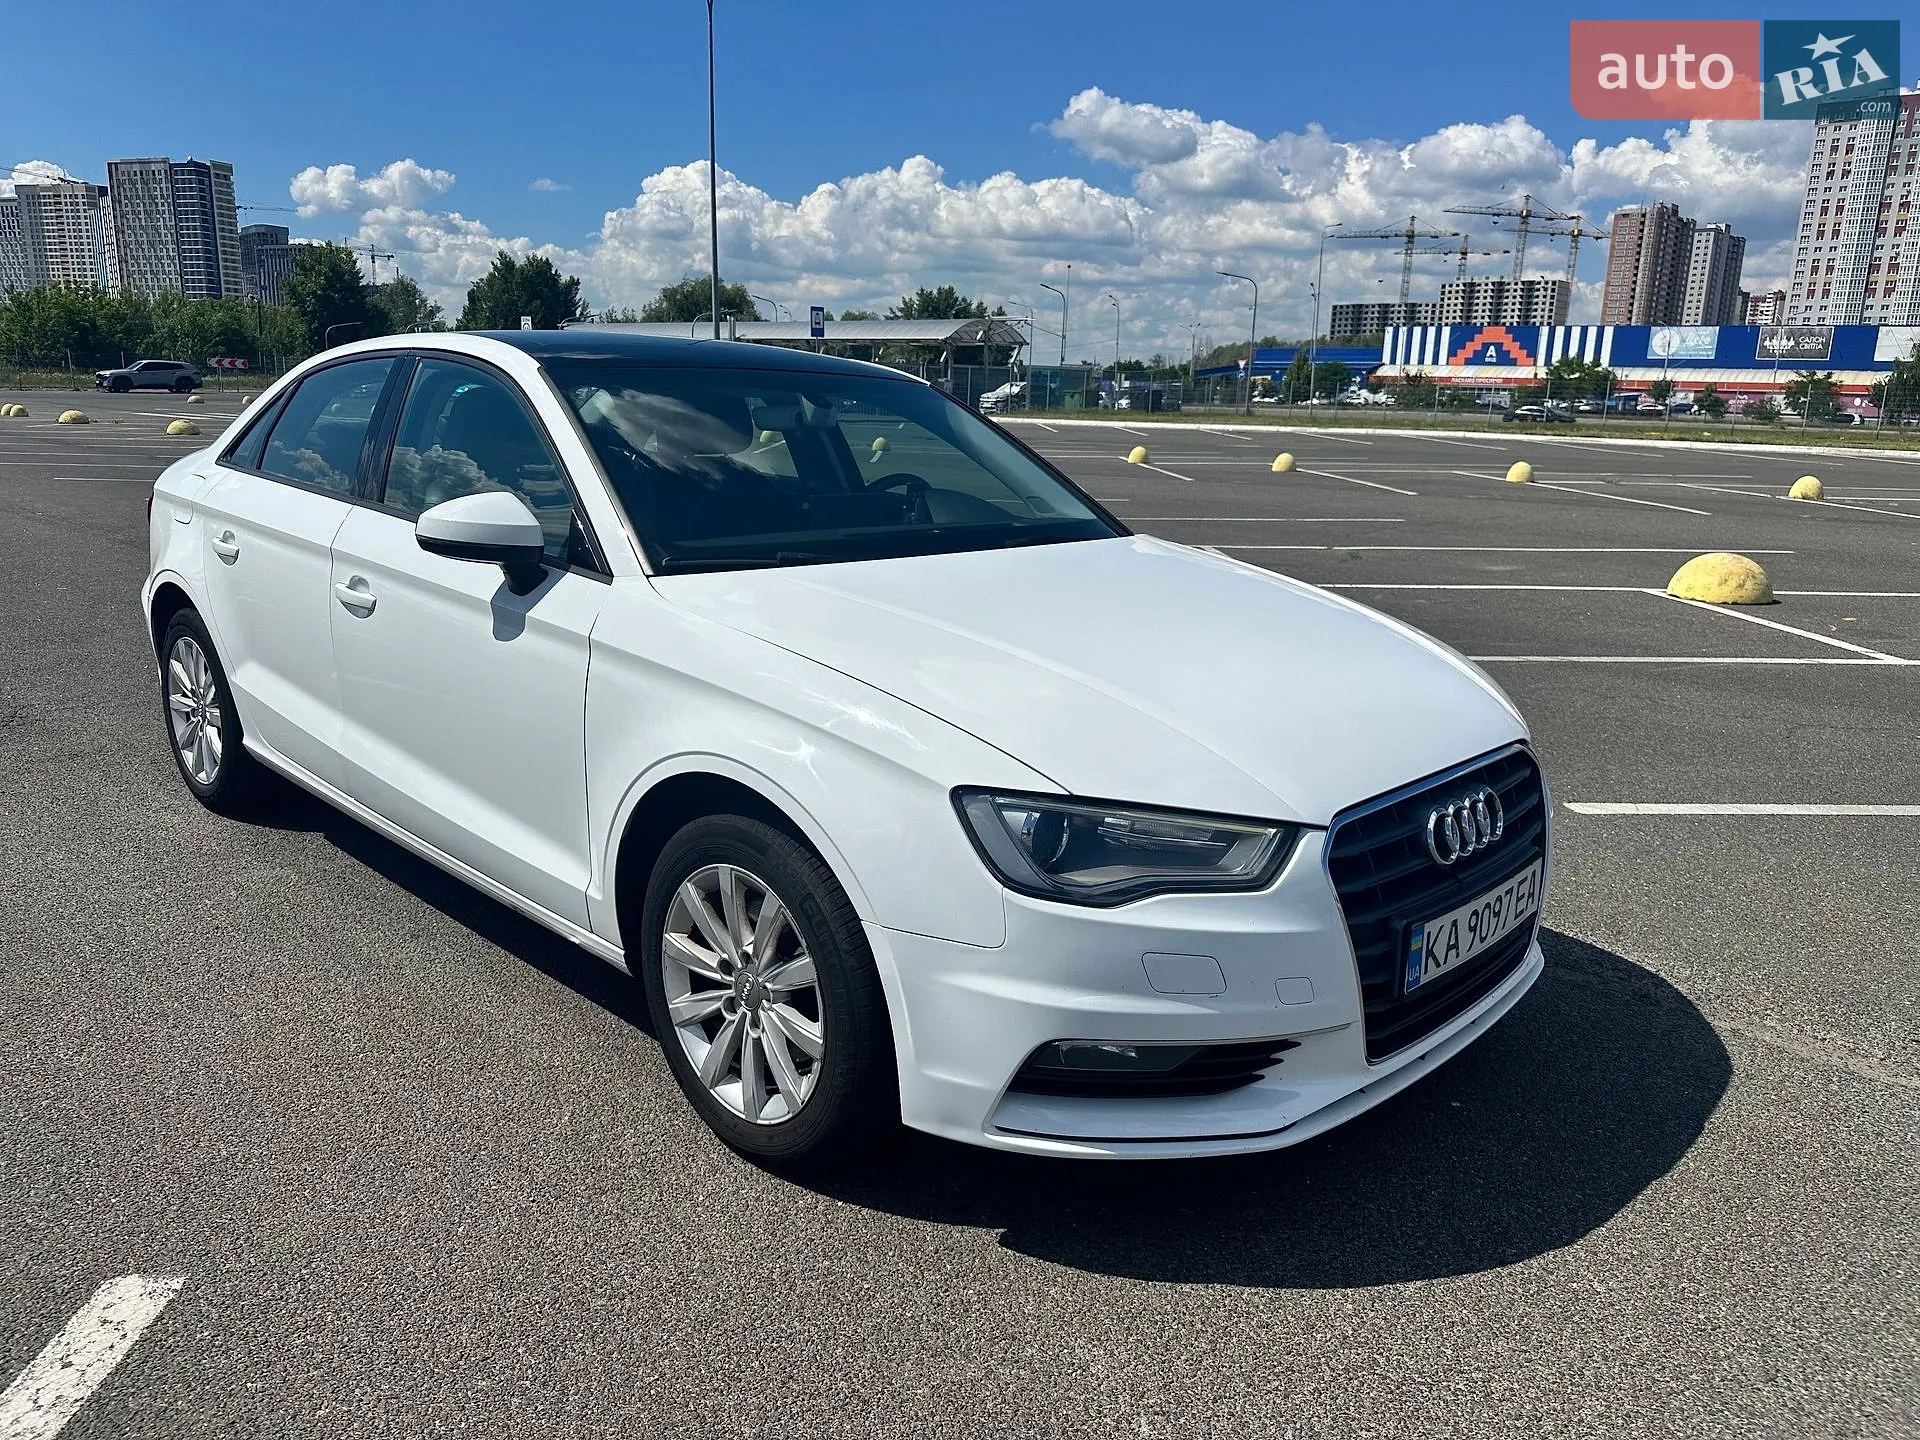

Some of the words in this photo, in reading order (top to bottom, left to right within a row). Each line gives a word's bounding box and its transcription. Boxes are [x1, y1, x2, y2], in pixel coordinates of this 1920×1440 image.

[1799, 342, 1823, 350] СВІТЛА
[1467, 886, 1513, 953] 9097
[1514, 869, 1537, 921] EA
[1409, 966, 1420, 981] UA
